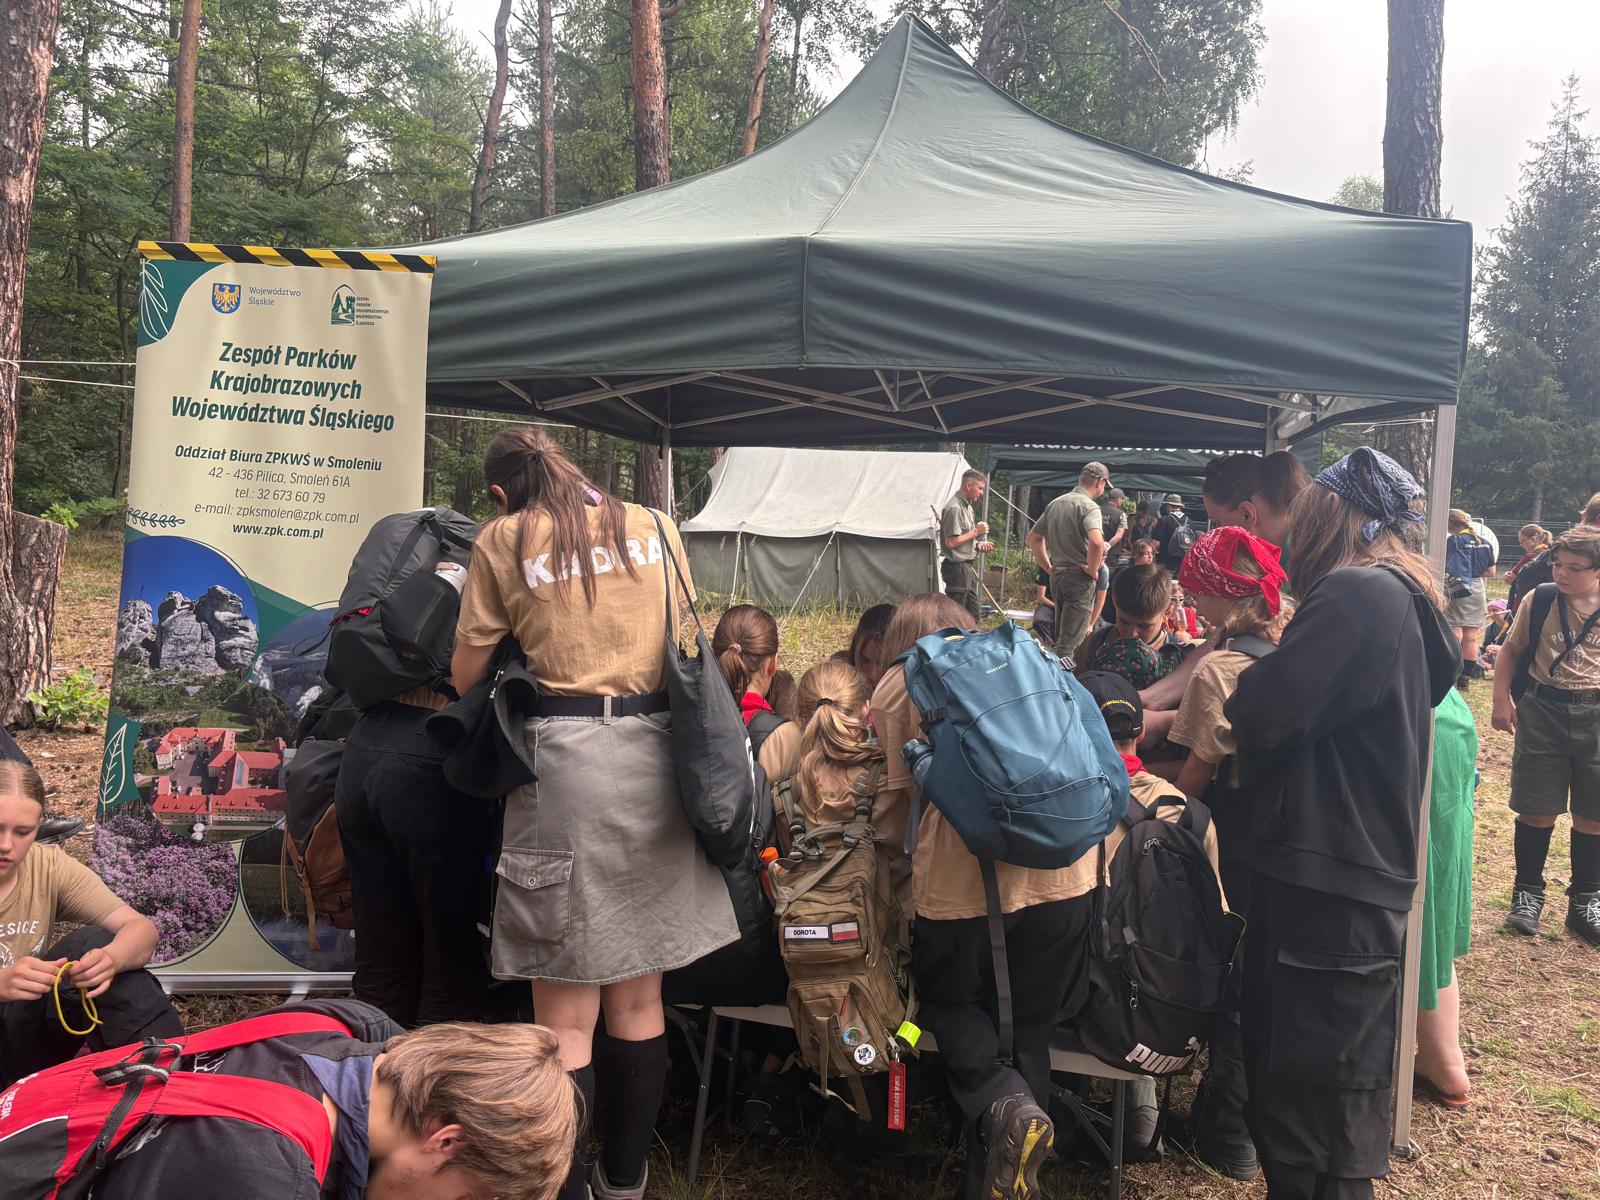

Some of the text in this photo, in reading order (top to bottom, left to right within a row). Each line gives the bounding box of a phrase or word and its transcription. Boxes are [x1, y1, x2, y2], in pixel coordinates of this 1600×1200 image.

[248, 296, 275, 306] Śląskie
[249, 287, 301, 296] Województwo
[219, 342, 357, 370] Zespół Parków
[209, 369, 362, 401] Krajobrazowych
[172, 396, 394, 433] Województwa Śląskiego
[175, 445, 382, 471] Oddział Biura ZPKWŚ w Smoleniu
[208, 466, 223, 478] 42
[233, 469, 253, 480] 436
[256, 470, 287, 484] Pilica,
[290, 472, 329, 486] Smoleń
[332, 475, 350, 487] 61A
[235, 488, 325, 503] tel.: 32 673 60 79
[194, 503, 359, 524] e-mail: zpksmolen@zpk.com.pl
[232, 524, 324, 539] www.zpk.com.pl
[523, 537, 663, 588] KADRA
